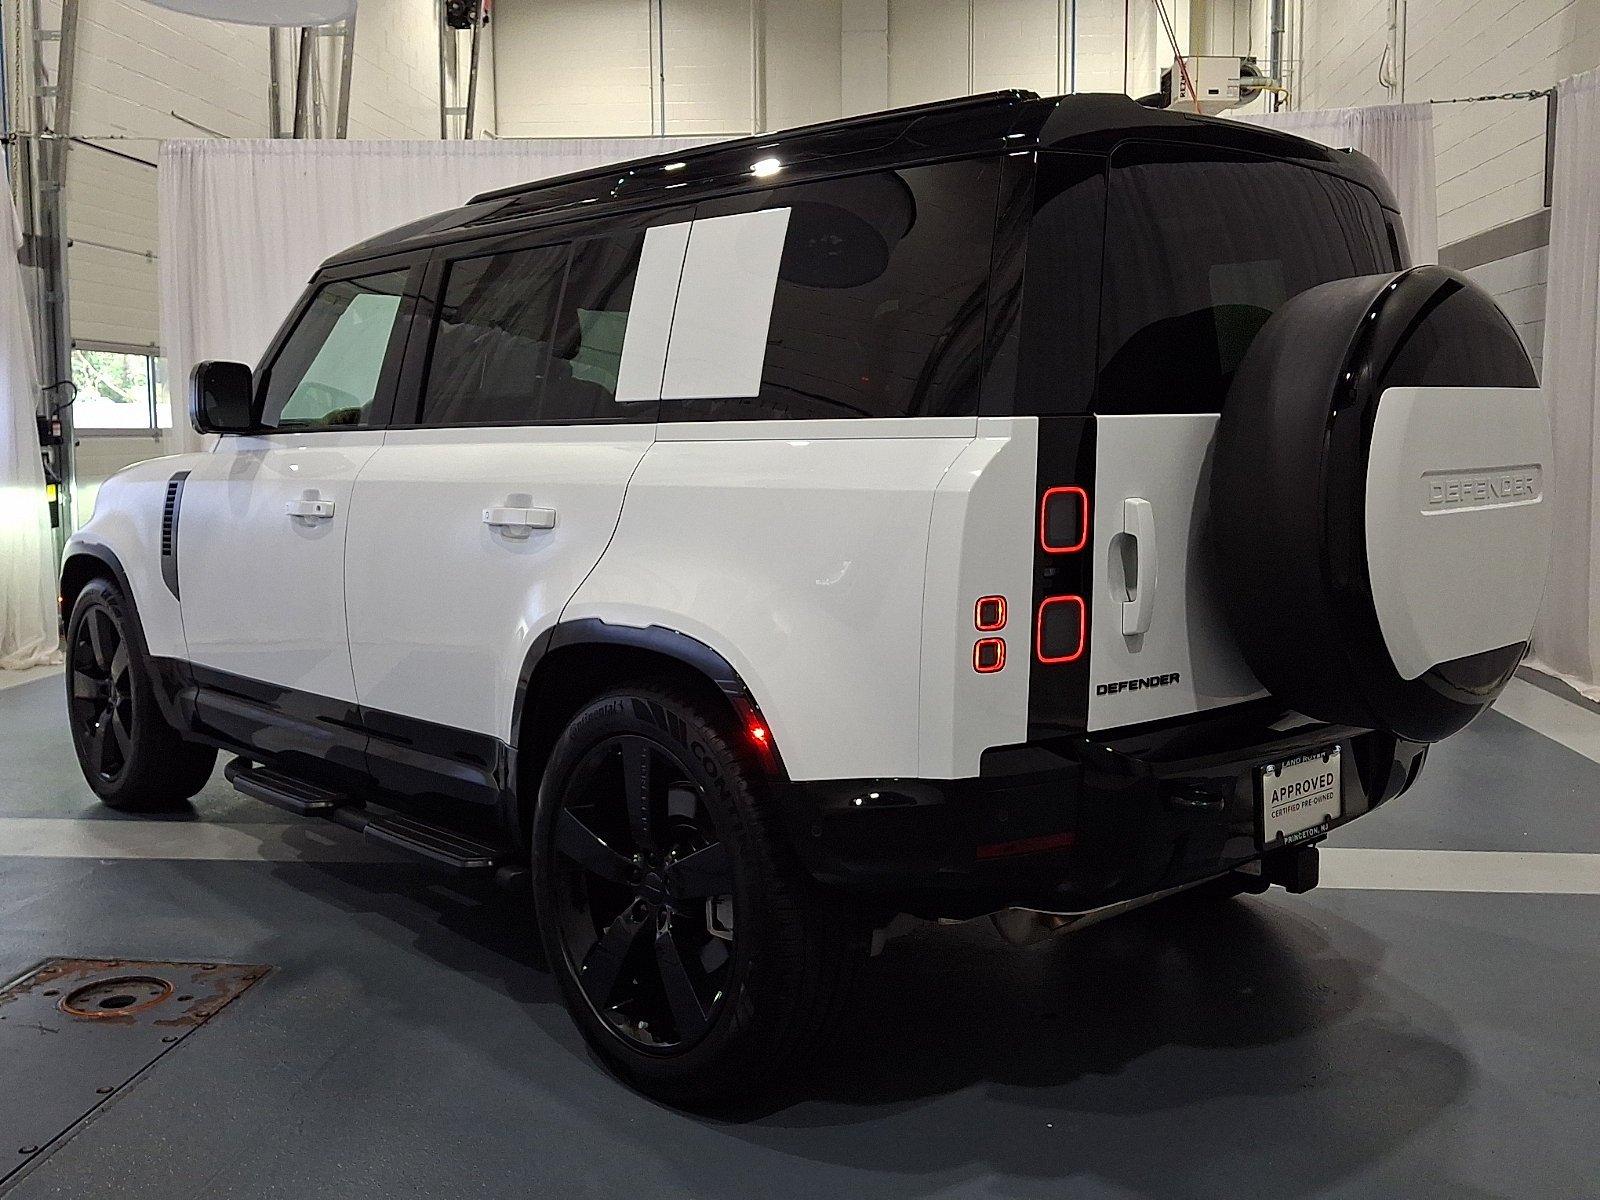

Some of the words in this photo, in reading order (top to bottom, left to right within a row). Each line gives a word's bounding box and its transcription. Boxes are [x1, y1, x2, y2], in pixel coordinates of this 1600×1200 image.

[1428, 477, 1534, 505] DEFENDER
[1096, 672, 1180, 696] DEFENDER
[1281, 757, 1301, 768] LAND
[1271, 772, 1334, 804] APPROVED
[1271, 803, 1300, 819] CERTIFIED
[1301, 792, 1334, 808] PRE-OWNED
